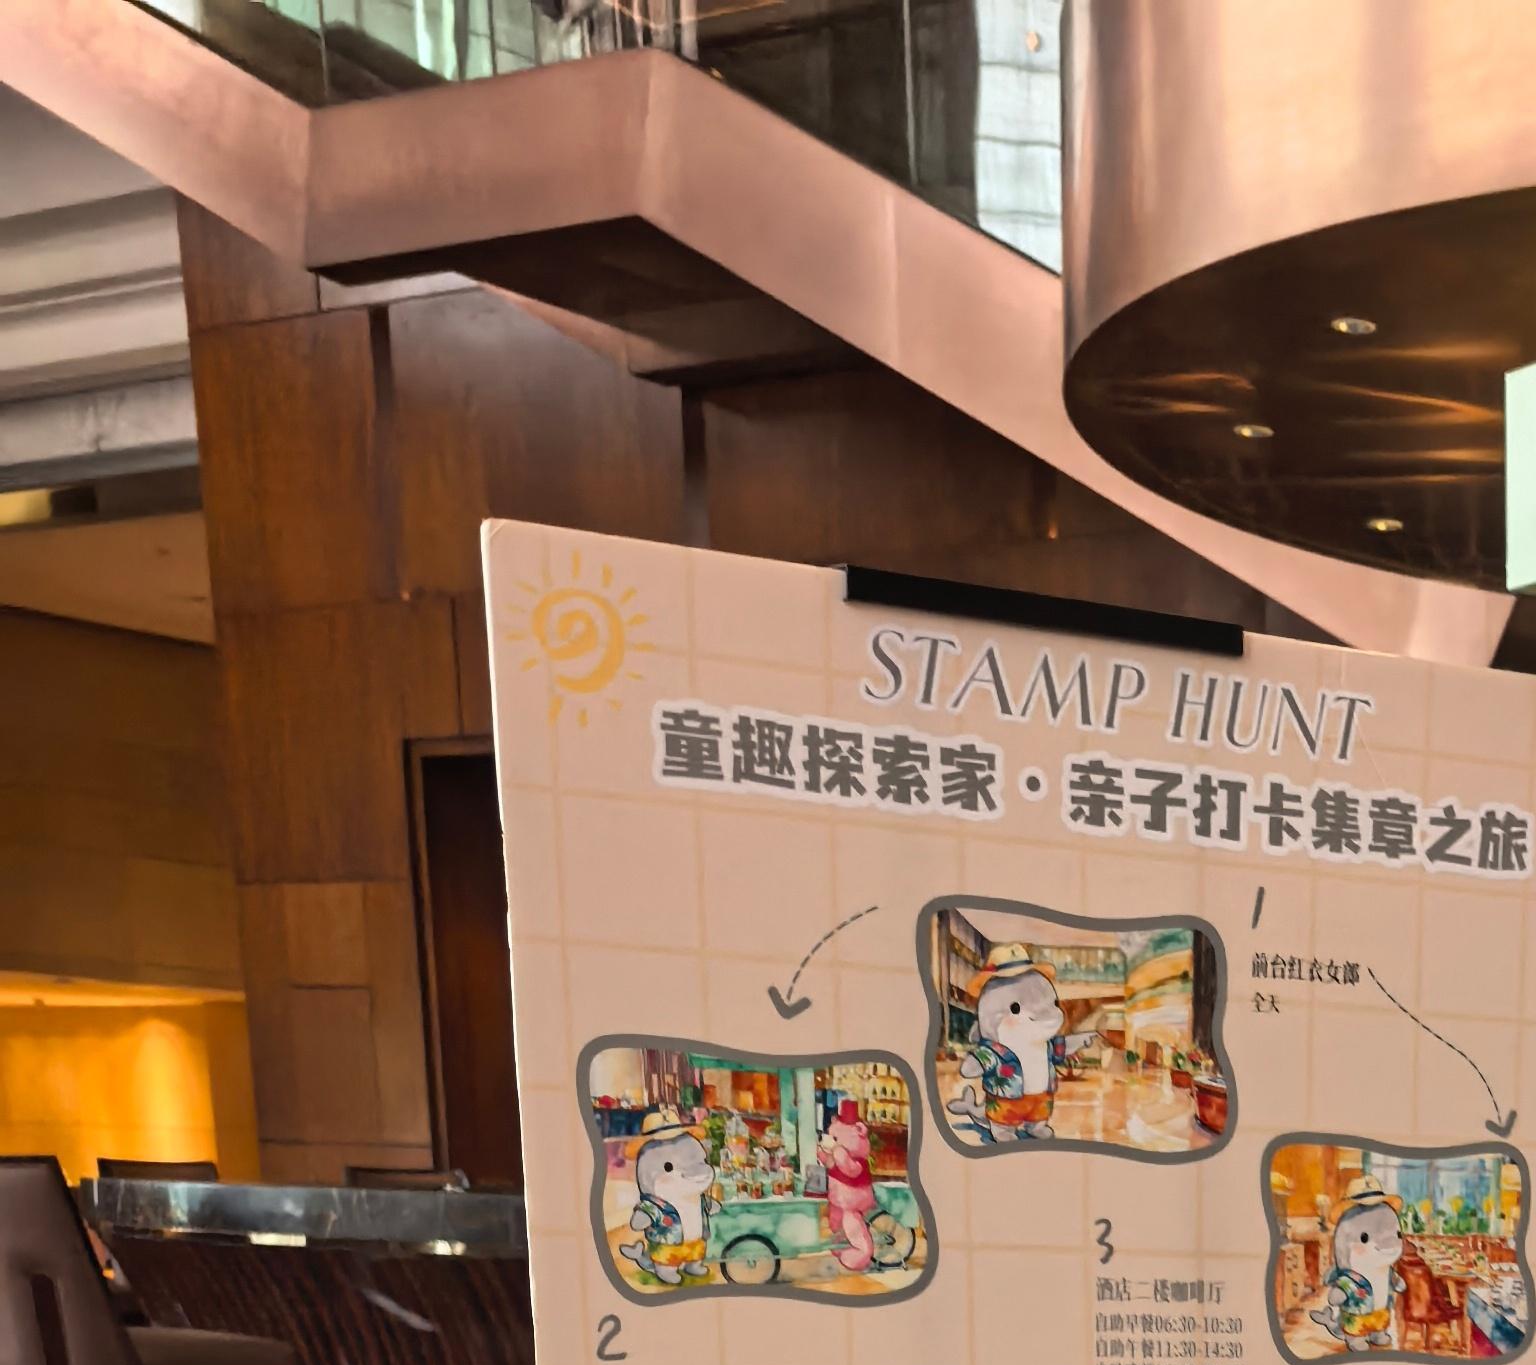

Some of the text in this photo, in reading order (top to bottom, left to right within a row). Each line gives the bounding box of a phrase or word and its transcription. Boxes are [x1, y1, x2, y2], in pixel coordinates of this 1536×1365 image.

[862, 626, 1375, 763] STAMP HUNT
[658, 707, 1530, 873] 童趣探索家·亲子打卡集章之旅
[1251, 951, 1361, 987] 前台红衣女郎
[1252, 991, 1281, 1014] 全天
[1094, 1218, 1115, 1264] 3
[1096, 1276, 1227, 1305] 酒店二楼咖啡厅
[596, 1313, 628, 1362] 2
